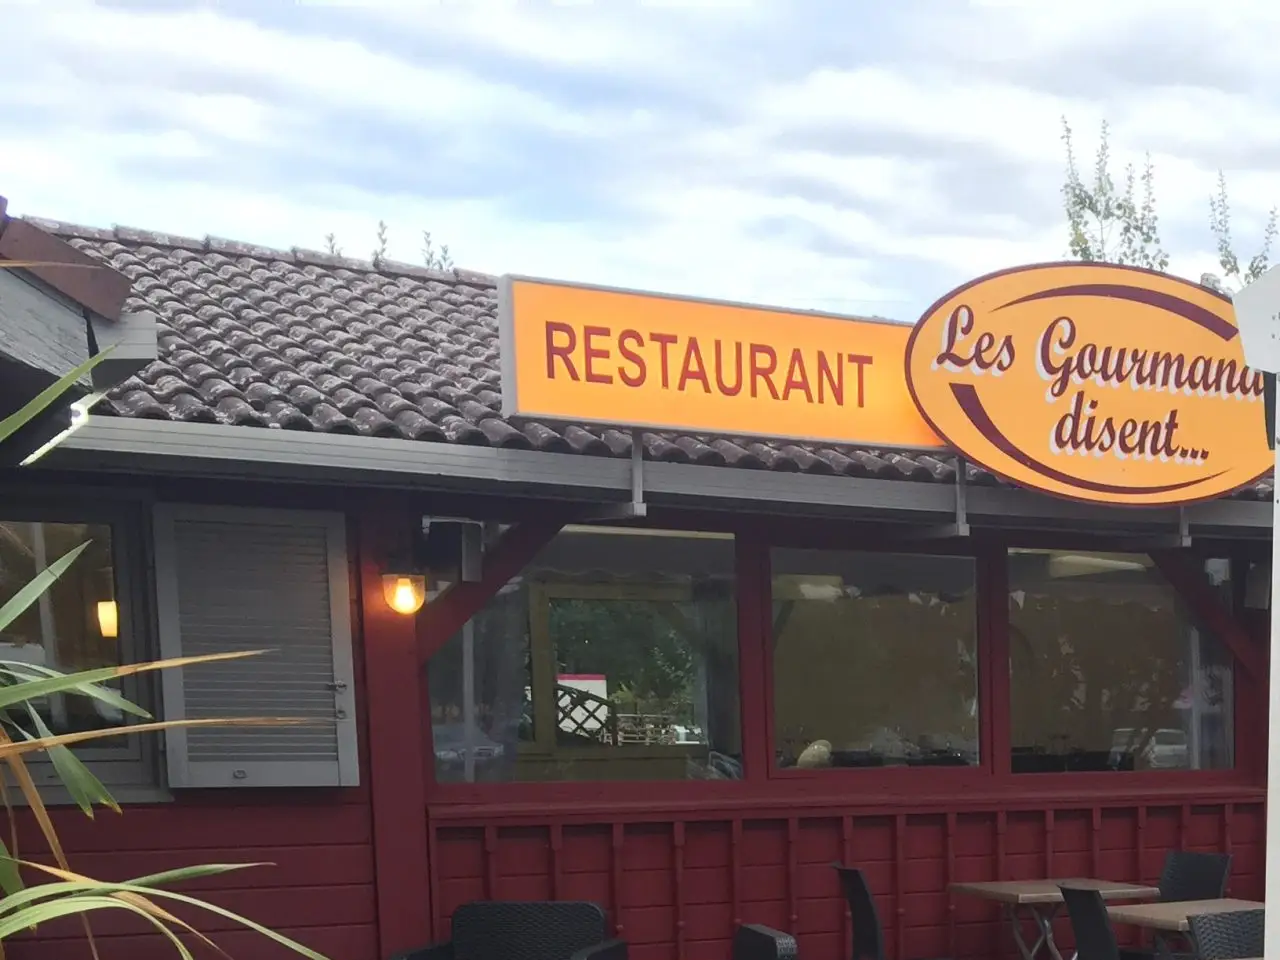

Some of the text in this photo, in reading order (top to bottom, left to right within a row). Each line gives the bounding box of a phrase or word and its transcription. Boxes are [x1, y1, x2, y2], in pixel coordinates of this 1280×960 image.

[545, 320, 874, 410] RESTAURANT
[934, 303, 1016, 374] Les
[1053, 390, 1210, 462] disent...
